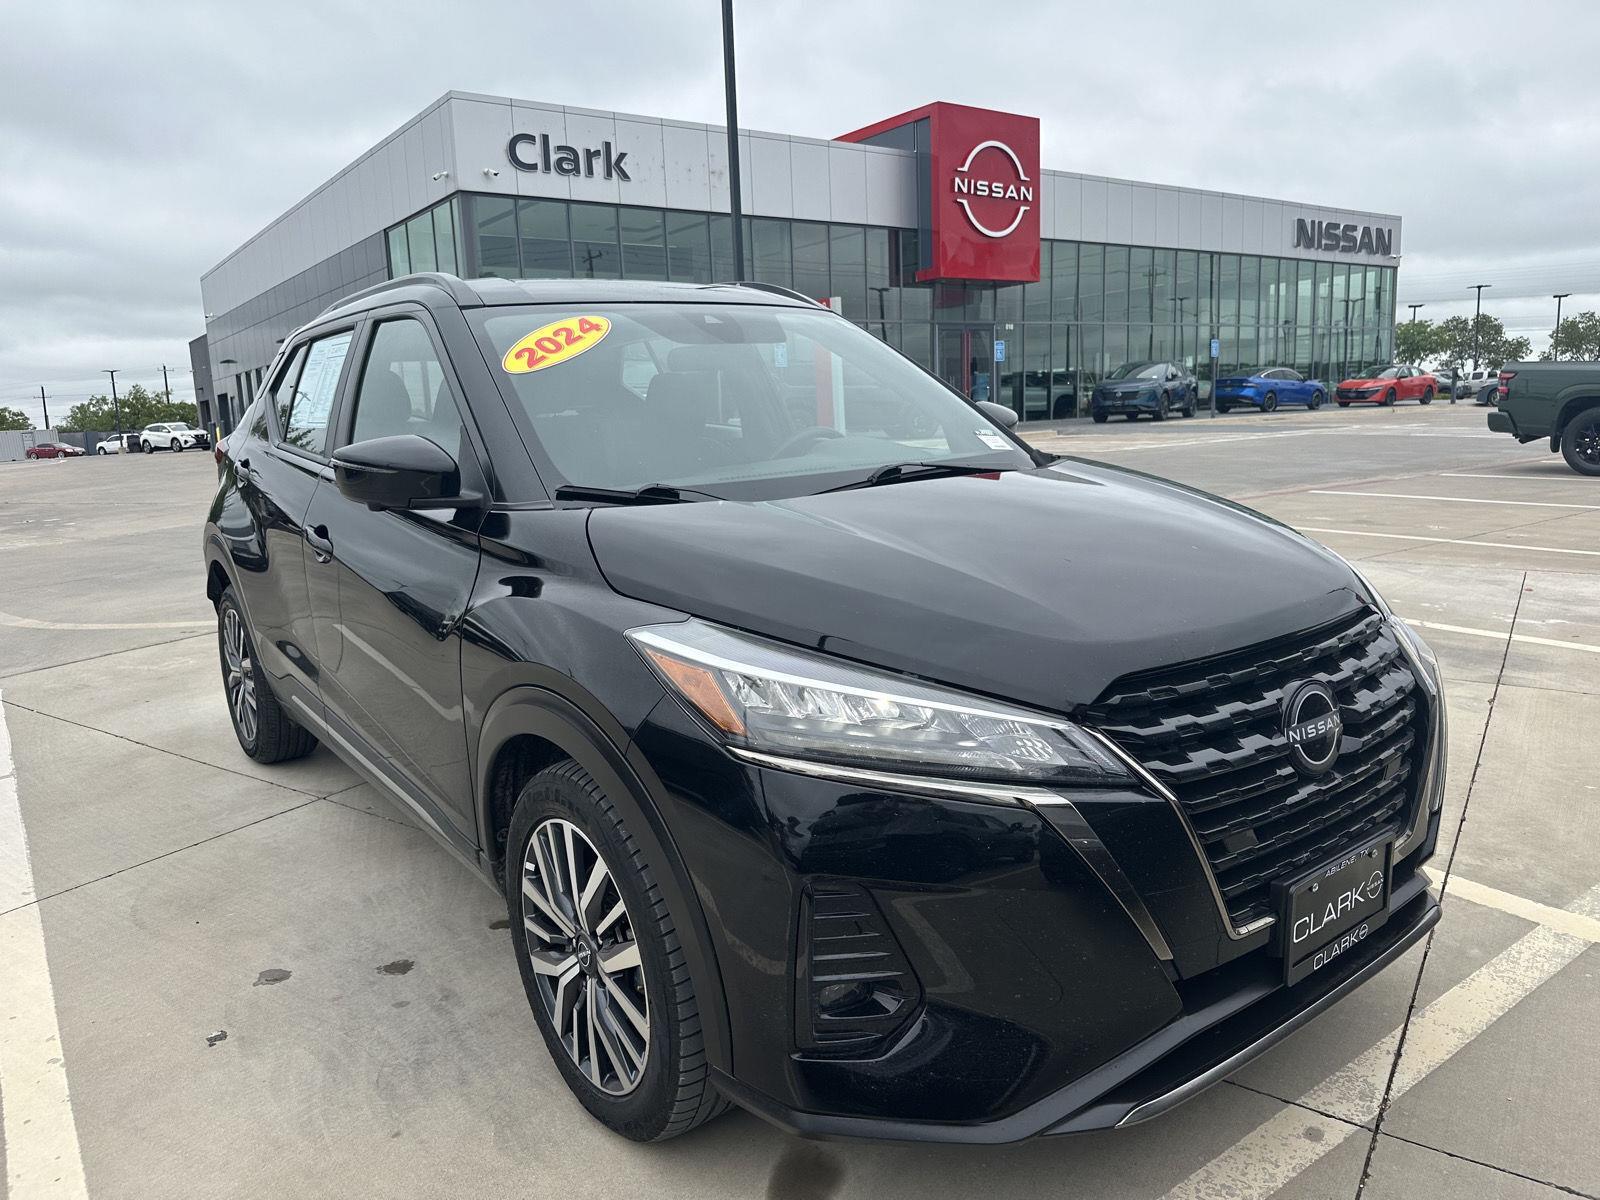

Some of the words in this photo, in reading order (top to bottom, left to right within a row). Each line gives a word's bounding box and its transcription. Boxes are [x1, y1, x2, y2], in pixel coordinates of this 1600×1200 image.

[507, 132, 632, 182] Clark
[954, 176, 1033, 202] NISSAN
[1294, 218, 1393, 256] NISSAN
[514, 317, 603, 369] 2024
[1288, 712, 1341, 743] NISSAN
[1360, 847, 1370, 858] TX
[1293, 881, 1366, 944] CLARK
[1313, 929, 1359, 971] CLARK
